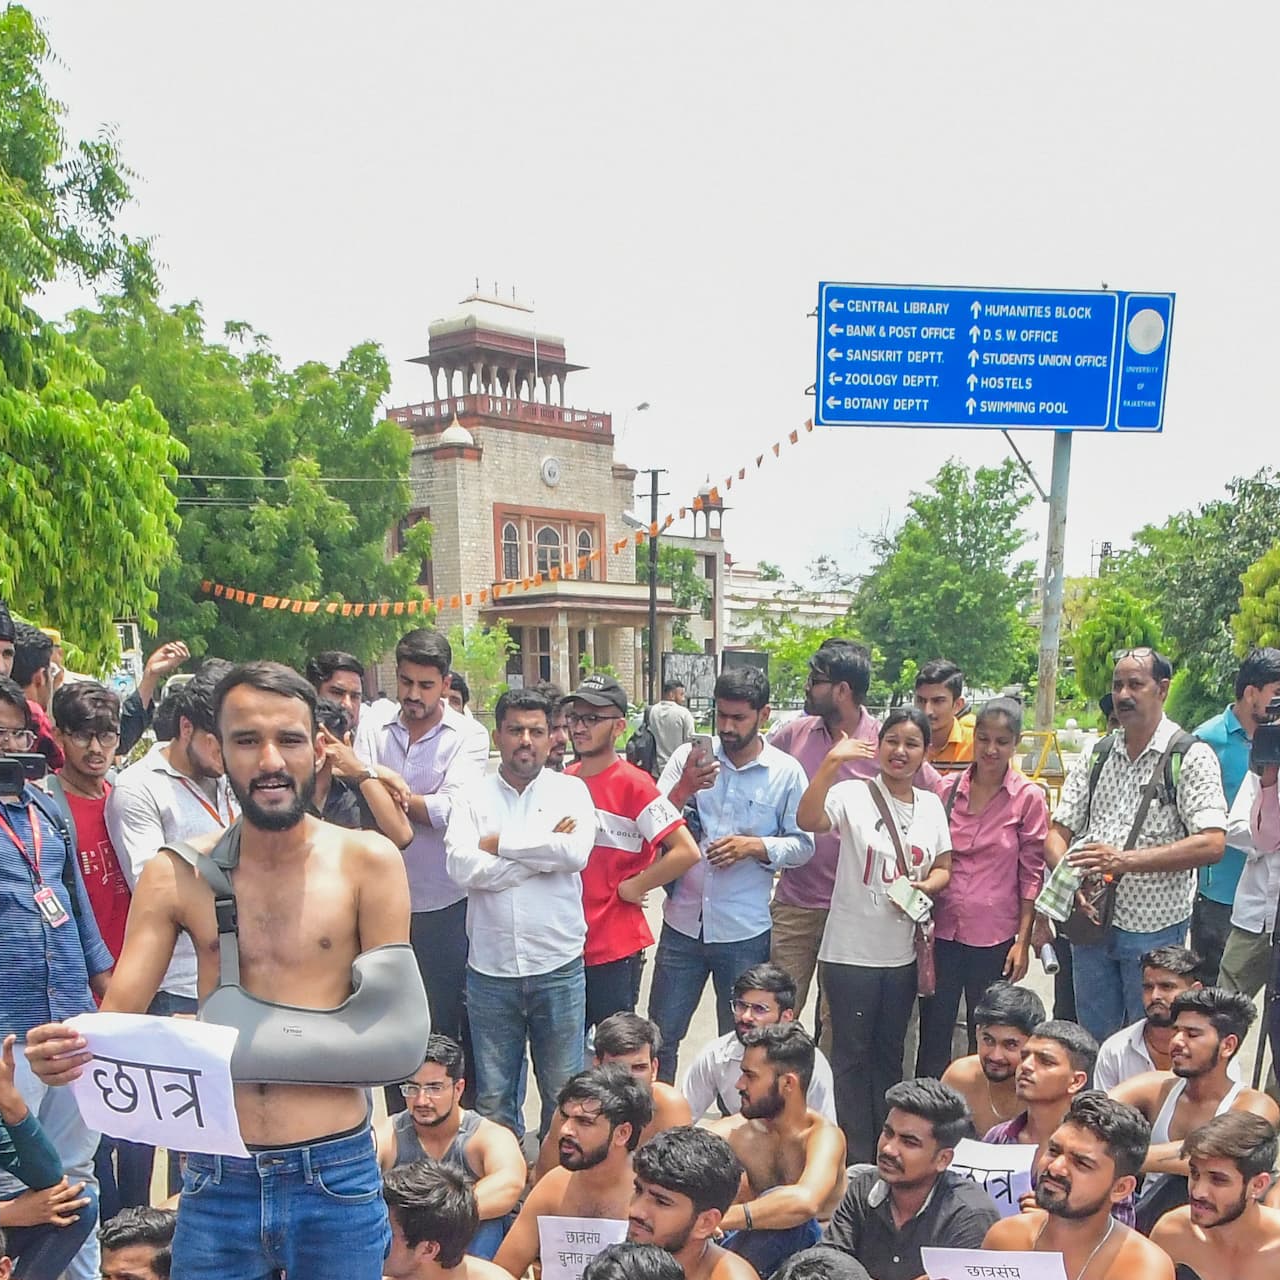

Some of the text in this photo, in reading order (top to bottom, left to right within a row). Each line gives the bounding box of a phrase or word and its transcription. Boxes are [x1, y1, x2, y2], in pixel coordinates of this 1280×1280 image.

[847, 300, 949, 315] CENTRAL LIBRARY
[984, 304, 1091, 319] HUMANITIES BLOCK
[846, 325, 955, 340] BANK & POST OFFICE
[1020, 330, 1058, 343] OFFICE
[846, 349, 944, 364] SANSKRIT DEPTT.
[982, 352, 1108, 367] STUDENTS UNION OFFICE
[845, 373, 940, 388] ZOOLOGY DEPTT.
[980, 376, 1033, 390] HOSTELS
[844, 398, 929, 411] BOTANY DEPTT
[980, 400, 1069, 414] SWIMMING POOL
[92, 1053, 206, 1128] छात्र
[558, 1251, 584, 1267] चुनाव
[964, 1264, 1021, 1279] छात्रसंघ
